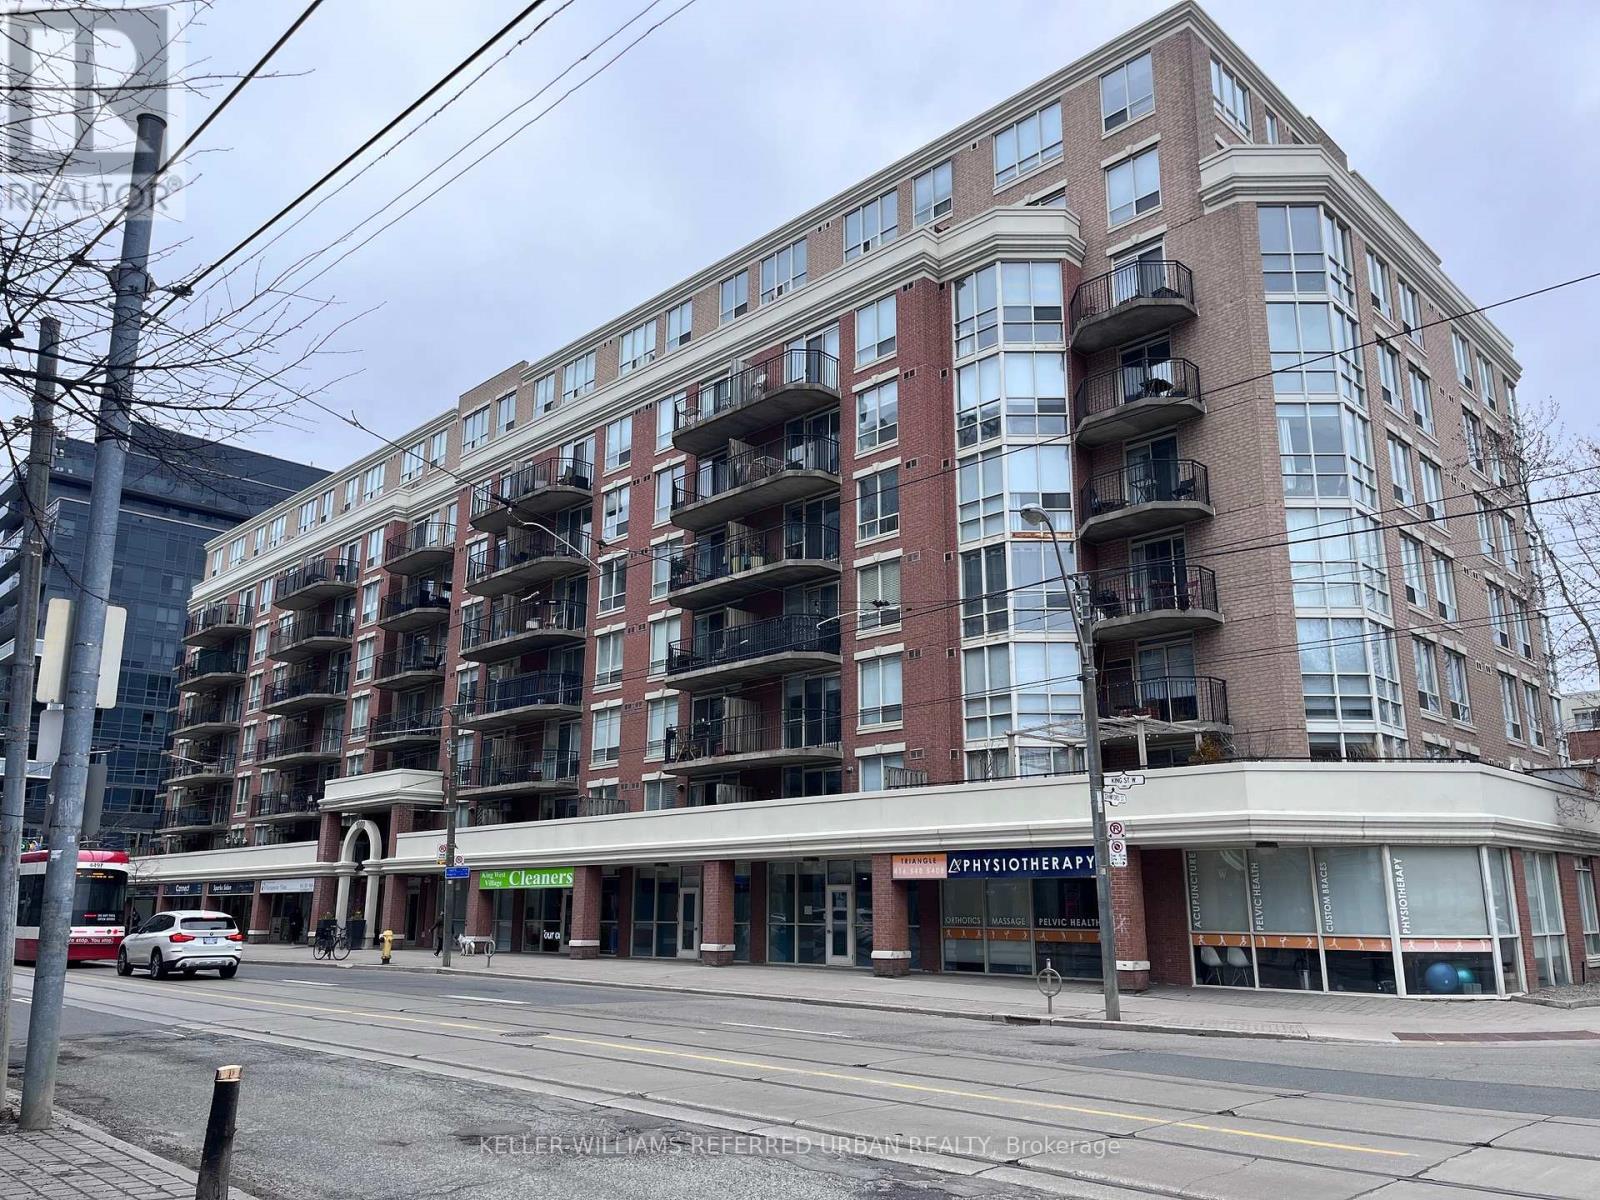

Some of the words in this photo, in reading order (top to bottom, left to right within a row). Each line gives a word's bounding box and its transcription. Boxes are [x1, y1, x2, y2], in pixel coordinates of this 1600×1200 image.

[900, 857, 937, 865] TRIANGLE
[963, 855, 1095, 873] PHYSIOTHERAPY
[509, 871, 573, 886] Cleaners
[1189, 851, 1202, 928] ACUPUNCTURE
[1251, 863, 1261, 896] HEALTH
[1320, 862, 1329, 893] BRACES
[1393, 858, 1411, 934] PHYSIOTHERAPY
[945, 916, 981, 925] ORTHOTICS
[991, 917, 1026, 926] MASSAGE
[1038, 918, 1067, 927] PELVIC
[1253, 898, 1264, 930] PELVIC
[1323, 896, 1333, 932] CUSTOM
